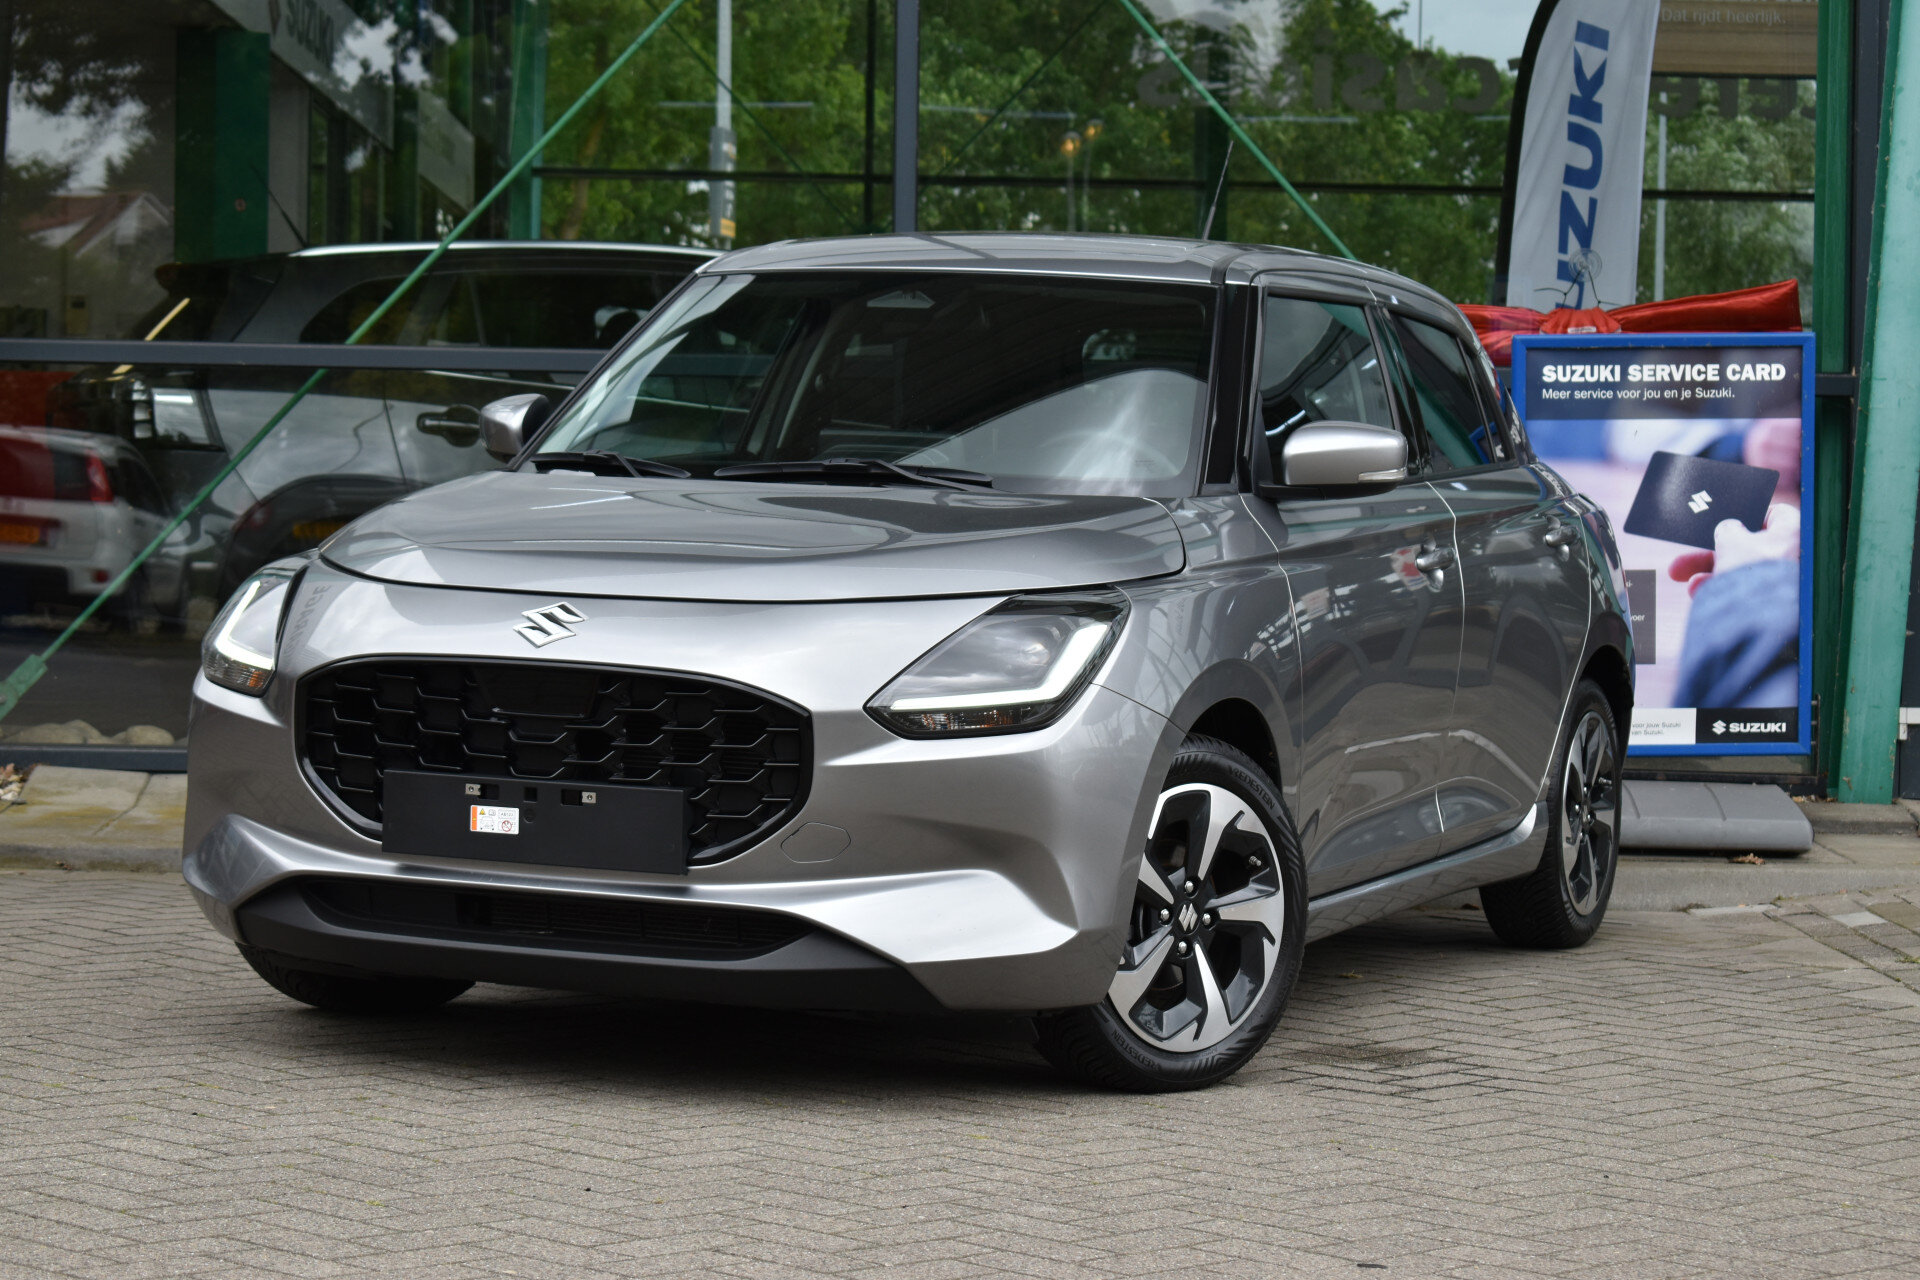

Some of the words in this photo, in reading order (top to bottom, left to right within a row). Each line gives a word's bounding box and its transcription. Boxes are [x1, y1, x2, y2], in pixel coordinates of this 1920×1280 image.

[1661, 8, 1688, 22] Dat
[1693, 8, 1722, 26] rijdt
[1726, 9, 1787, 27] heerlijk.
[1555, 20, 1610, 310] UZUKI
[1542, 365, 1621, 382] SUZUKI
[1627, 364, 1720, 382] SERVICE
[1726, 363, 1786, 381] CARD
[1542, 388, 1571, 399] Meer
[1574, 388, 1613, 399] service
[1617, 389, 1641, 398] voor
[1642, 388, 1661, 400] jou
[1664, 389, 1678, 398] en
[1680, 388, 1692, 400] je
[1695, 387, 1735, 398] Suzuki.
[1729, 722, 1787, 733] SUZUKI
